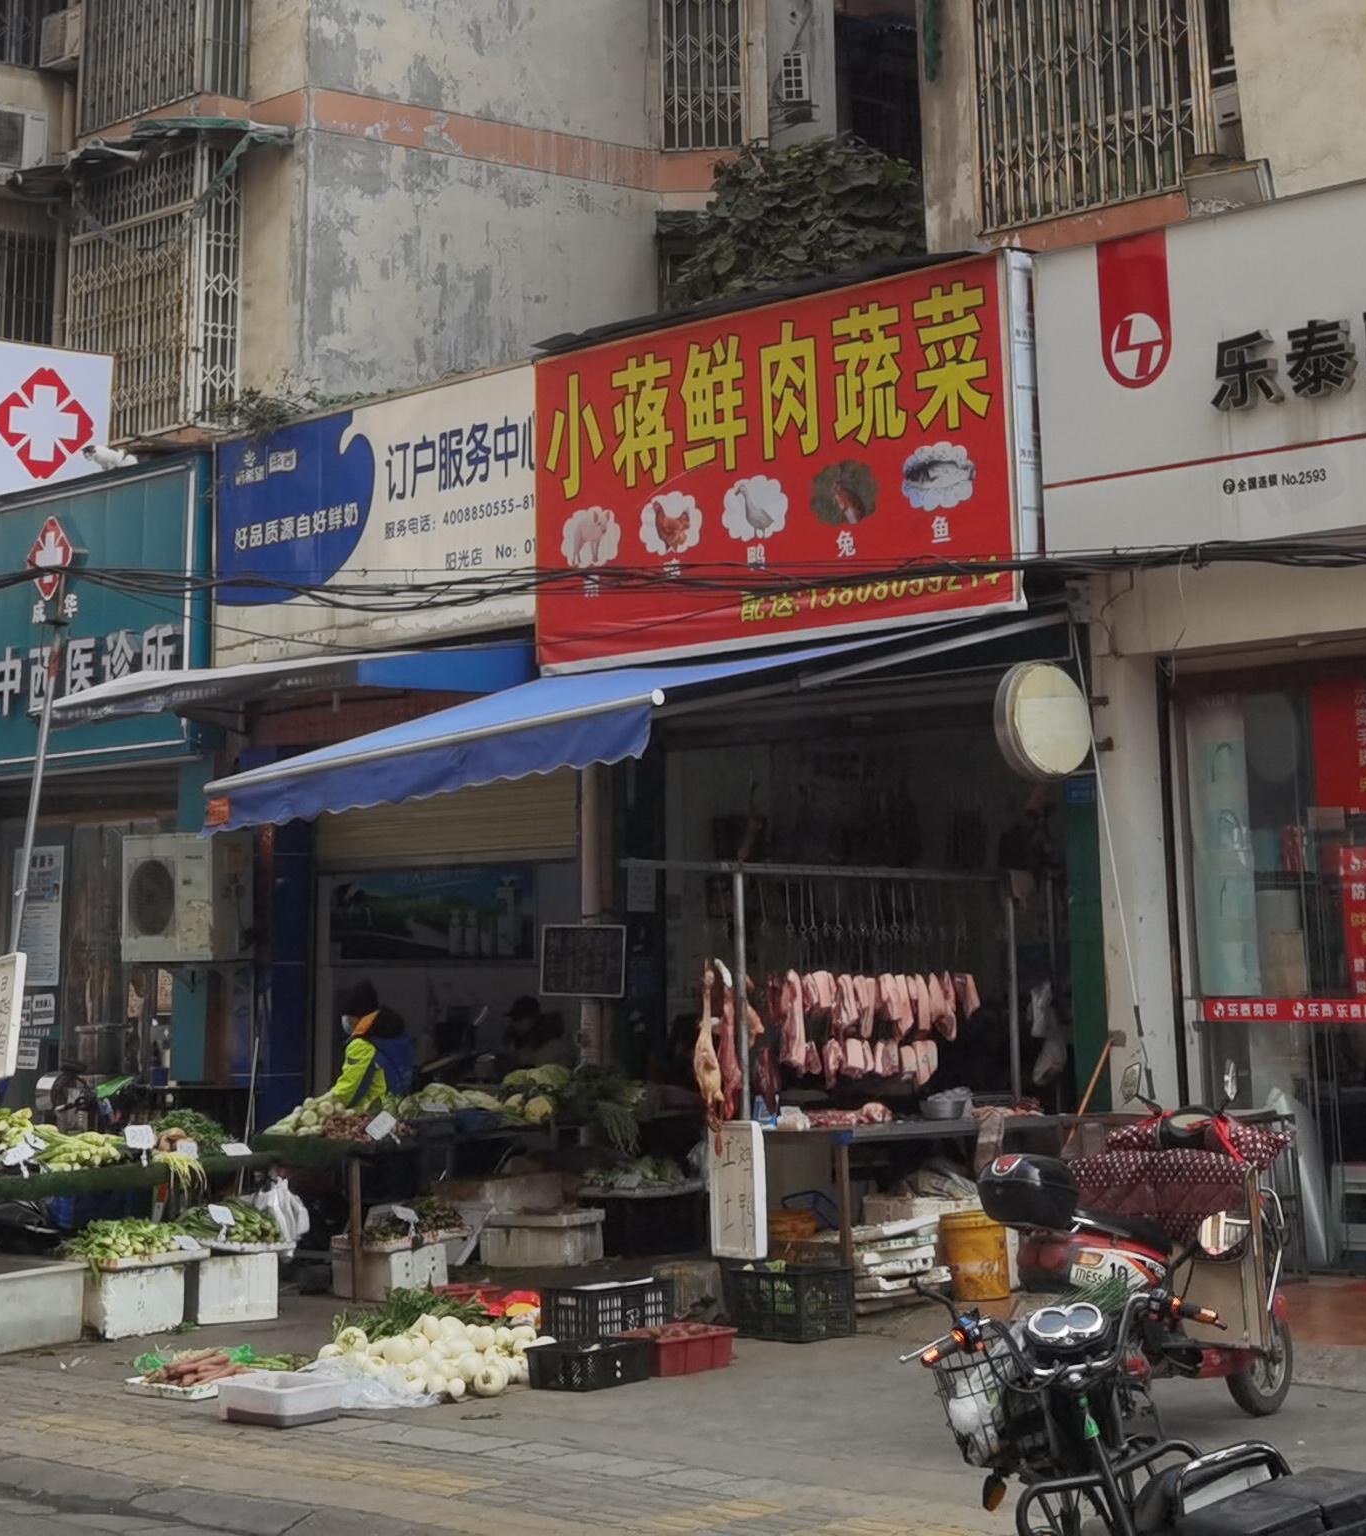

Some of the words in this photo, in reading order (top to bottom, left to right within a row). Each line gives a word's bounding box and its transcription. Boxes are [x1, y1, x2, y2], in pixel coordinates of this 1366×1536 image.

[545, 280, 991, 499] 小蒋鲜肉蔬菜
[234, 501, 359, 551] 好品质源自好鲜奶
[930, 516, 952, 544] 鱼
[836, 530, 857, 558] 兔
[445, 547, 483, 571] 阳光店
[1228, 1002, 1278, 1018] 乐泰亮甲
